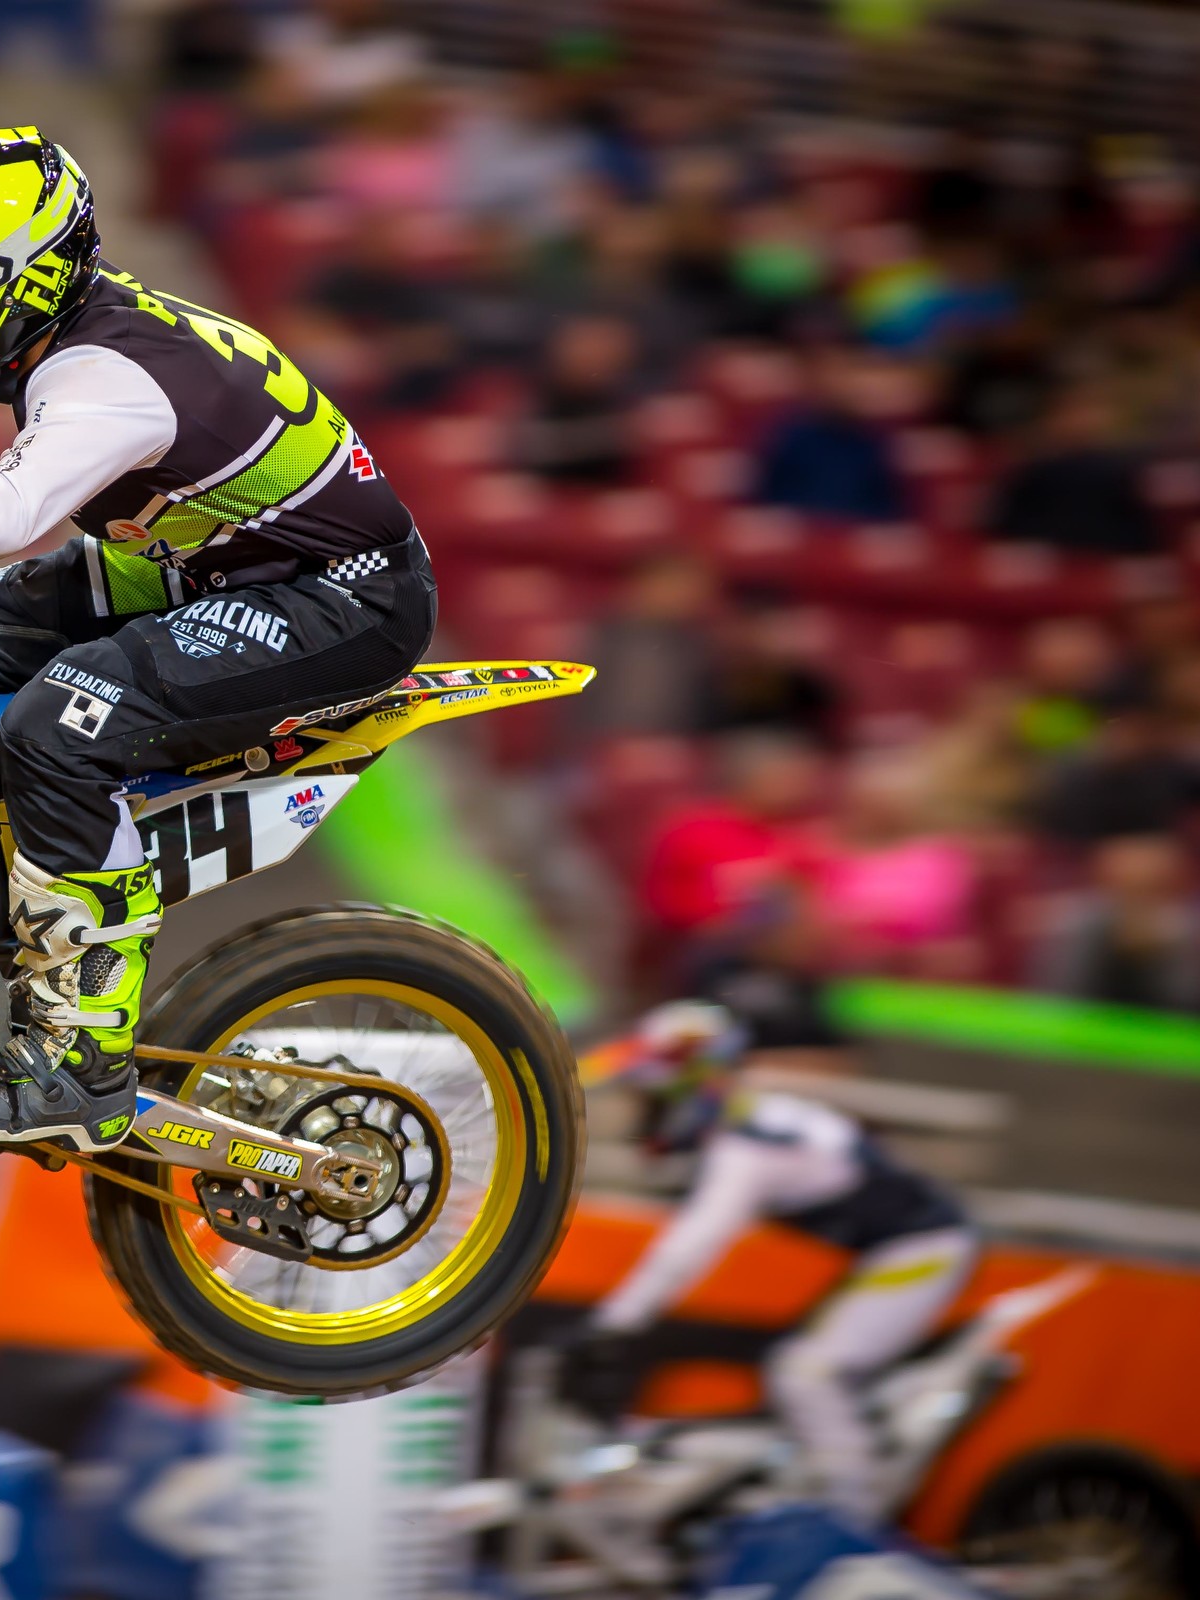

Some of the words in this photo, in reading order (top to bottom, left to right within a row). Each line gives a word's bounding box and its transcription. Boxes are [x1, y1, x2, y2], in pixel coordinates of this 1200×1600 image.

[13, 251, 65, 313] FLY
[47, 260, 73, 316] RACING
[172, 621, 194, 634] EST.
[196, 626, 228, 647] 1998
[182, 600, 288, 653] RACING
[49, 662, 76, 681] FLY
[71, 671, 123, 704] RACING
[440, 687, 489, 704] ECSTAR
[517, 682, 560, 693] TOYOTA
[284, 784, 324, 812] AMA
[147, 1120, 216, 1149] JGR
